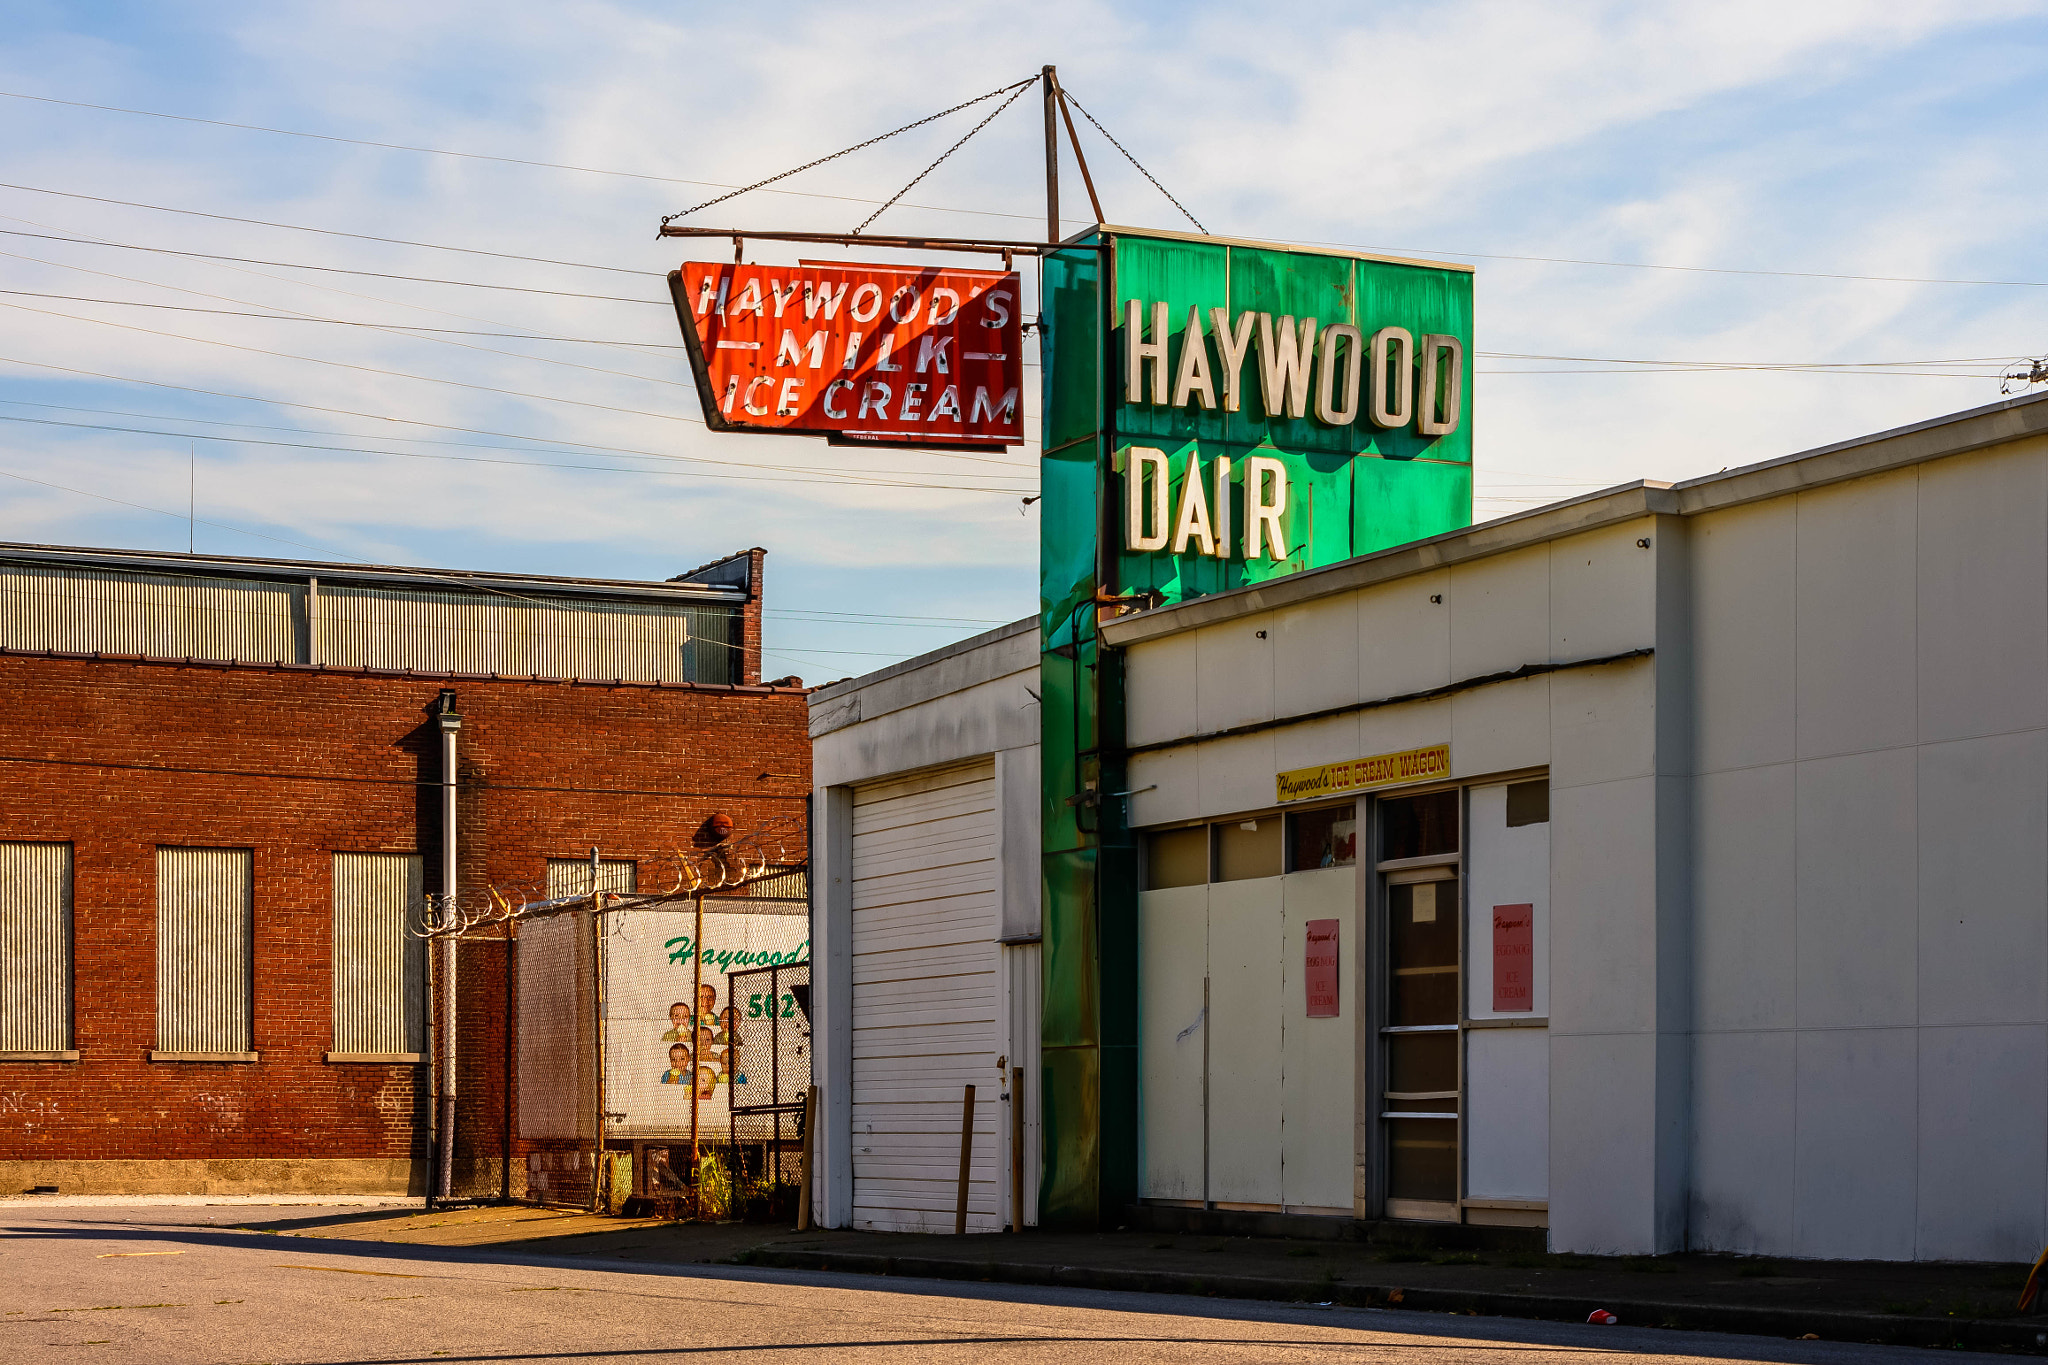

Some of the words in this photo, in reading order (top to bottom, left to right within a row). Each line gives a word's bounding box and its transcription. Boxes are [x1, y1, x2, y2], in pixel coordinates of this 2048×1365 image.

[697, 275, 1013, 329] HAYWOOD'S
[776, 329, 955, 374] MILK
[1125, 298, 1464, 436] HAYWOOD
[723, 374, 806, 417] ICE
[823, 378, 1019, 425] CREAM
[1125, 446, 1287, 561] DAIR
[1278, 768, 1330, 797] Haywood's
[1330, 765, 1350, 790] ICE
[1354, 758, 1395, 786] CREAM
[1398, 749, 1446, 779] WAGON
[1315, 981, 1328, 992] ICE
[1499, 986, 1526, 999] CREAM
[1505, 971, 1520, 983] ICE
[1310, 995, 1333, 1006] CREAM
